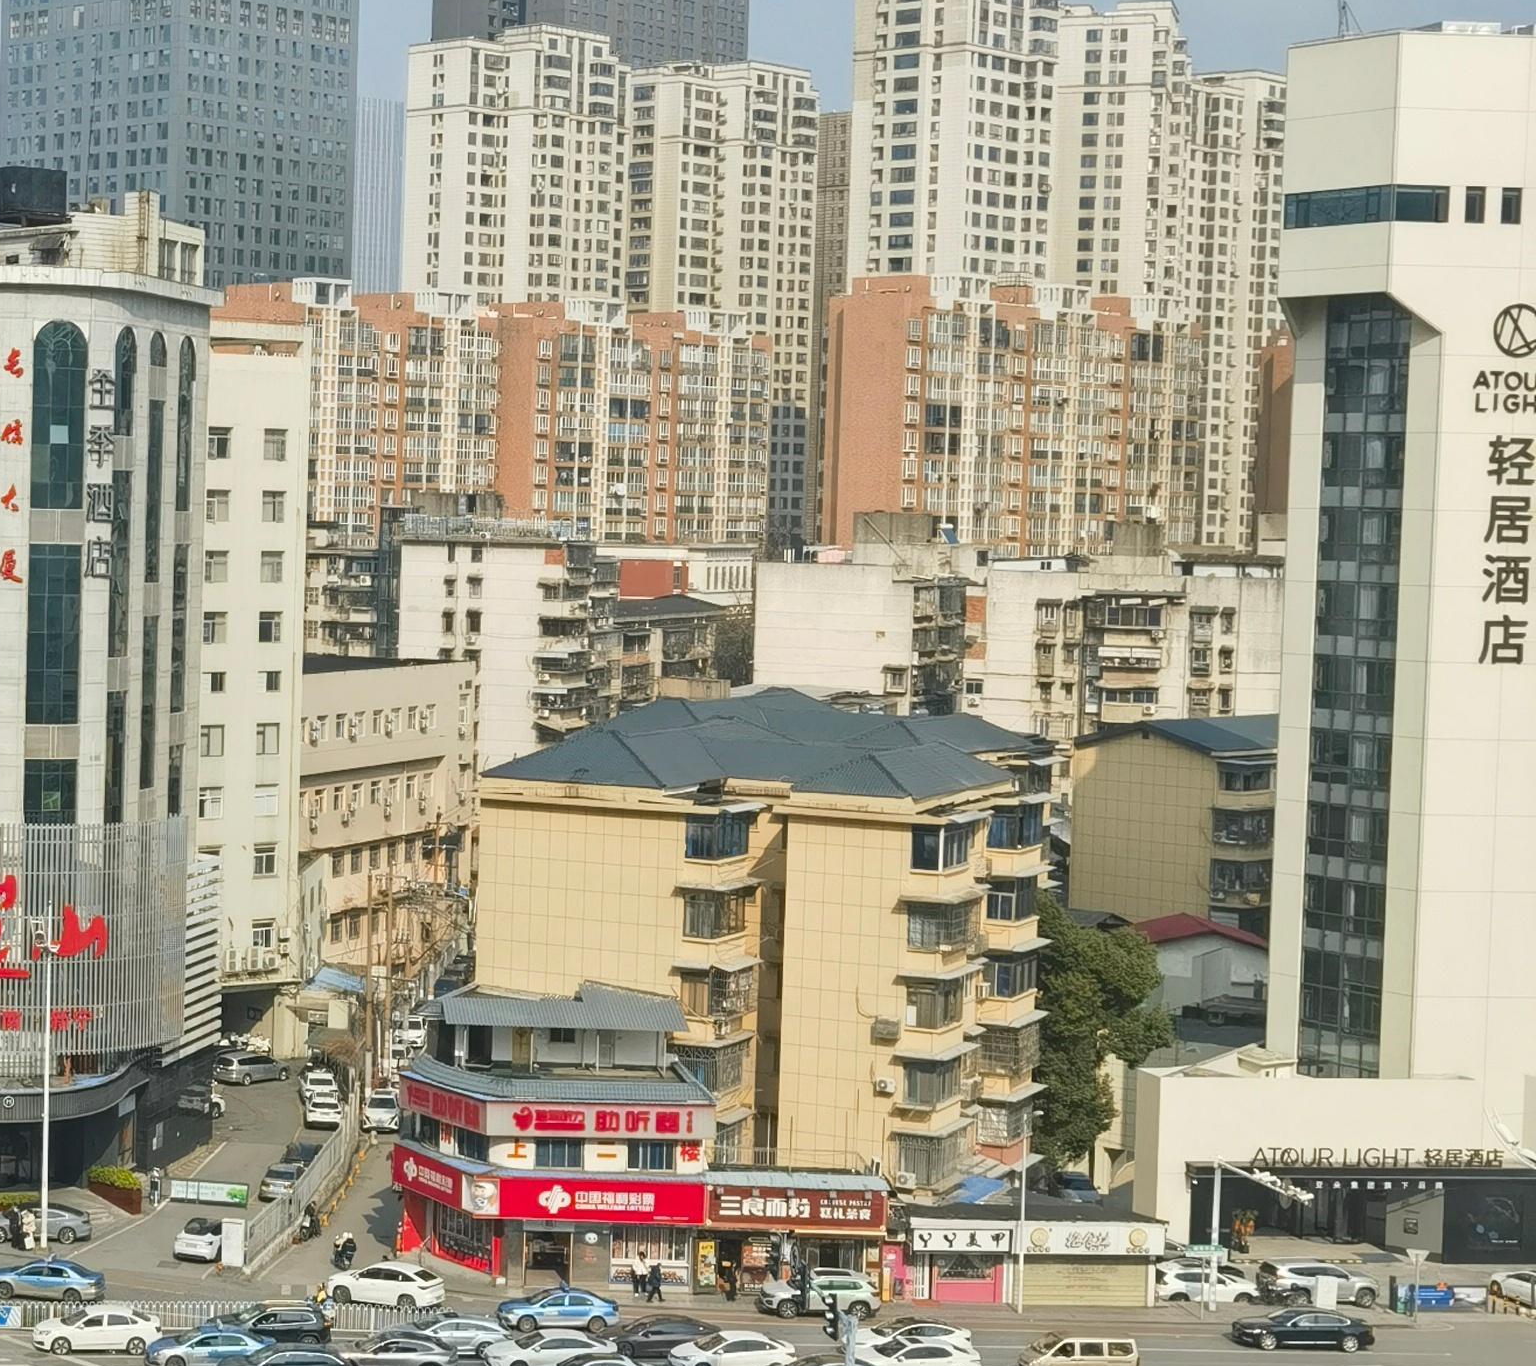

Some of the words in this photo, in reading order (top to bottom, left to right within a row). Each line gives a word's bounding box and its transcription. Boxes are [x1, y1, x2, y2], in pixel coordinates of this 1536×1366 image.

[84, 368, 115, 578] 全季酒店
[1478, 435, 1536, 665] 轻居酒店
[575, 1191, 655, 1204] 中国福利彩票
[1250, 1147, 1334, 1168] ATOUR
[1342, 1147, 1415, 1168] LIGHT
[1424, 1148, 1504, 1168] 轻居酒店
